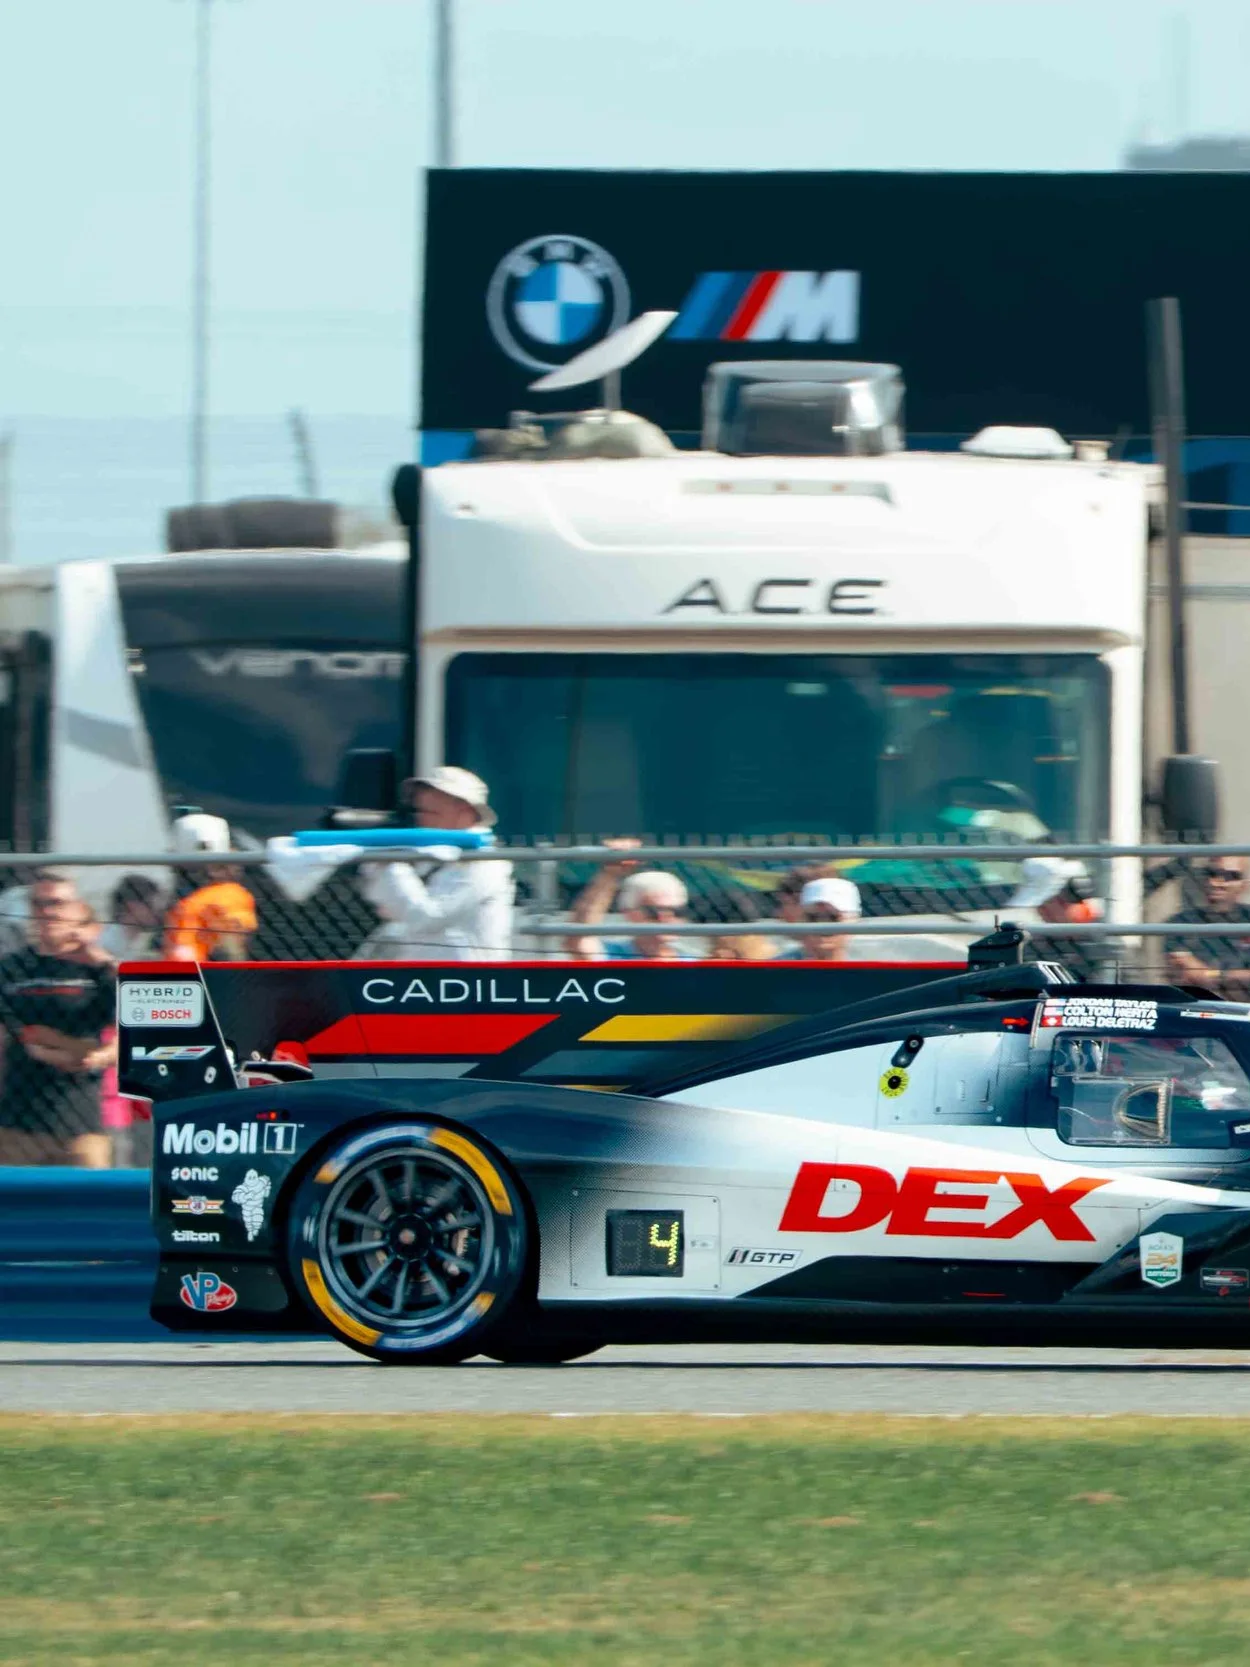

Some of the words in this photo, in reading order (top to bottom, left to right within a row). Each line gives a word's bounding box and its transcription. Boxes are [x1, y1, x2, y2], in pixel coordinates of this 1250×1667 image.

[362, 978, 626, 1004] CADILLAC
[1114, 999, 1158, 1009] TAYLOR
[151, 1009, 192, 1020] BOSCH
[1063, 1006, 1114, 1016] COLTON
[1114, 1008, 1158, 1018] HERTA
[1061, 1016, 1096, 1027] LOUIS
[1096, 1017, 1157, 1030] DELETRAZ
[162, 1122, 259, 1155] Mobil
[778, 1161, 1116, 1242] DEX
[171, 1229, 221, 1243] tilton
[649, 1221, 680, 1266] 4
[749, 1251, 796, 1264] GTP
[181, 1272, 221, 1311] VP
